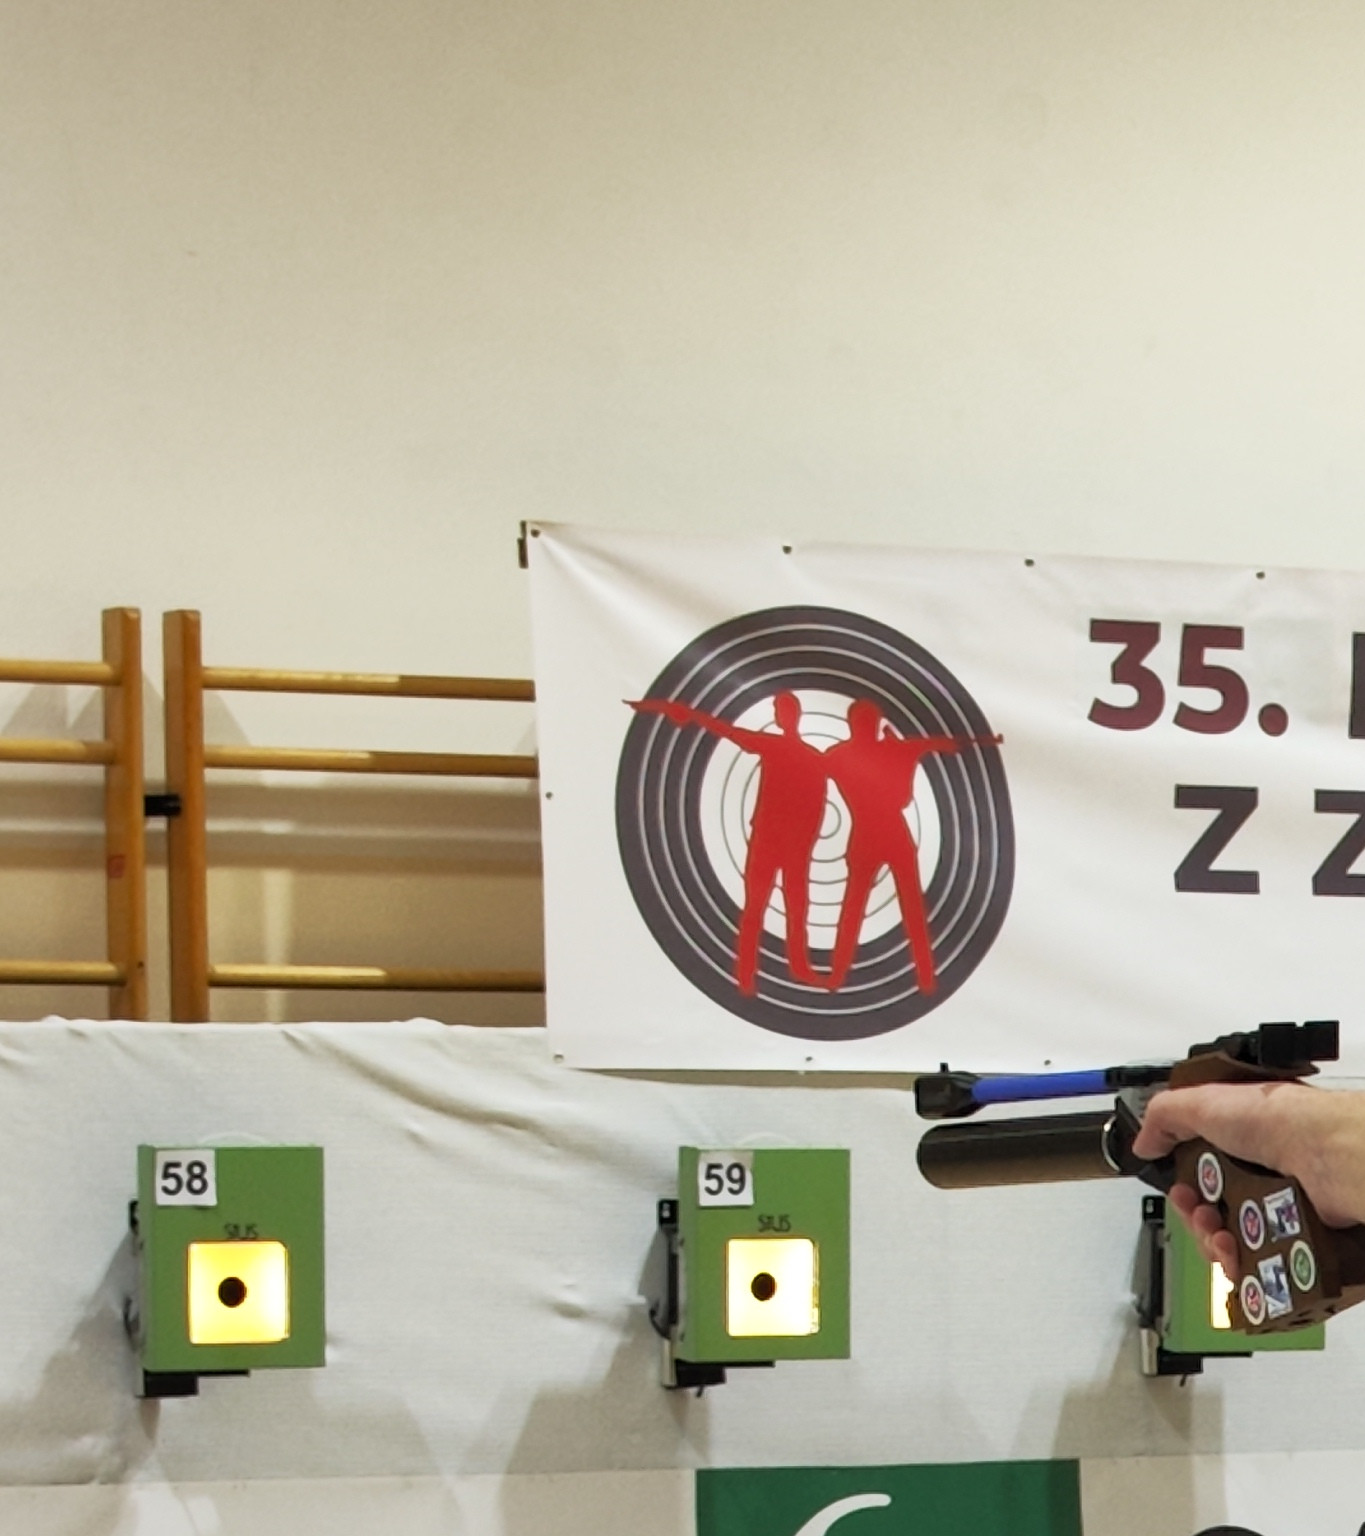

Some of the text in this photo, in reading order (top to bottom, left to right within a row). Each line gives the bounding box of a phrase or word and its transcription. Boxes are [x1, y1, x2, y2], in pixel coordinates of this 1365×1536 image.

[1087, 618, 1289, 736] 35.
[1173, 784, 1260, 895] Z
[161, 1160, 208, 1195] 58
[704, 1162, 746, 1195] 59
